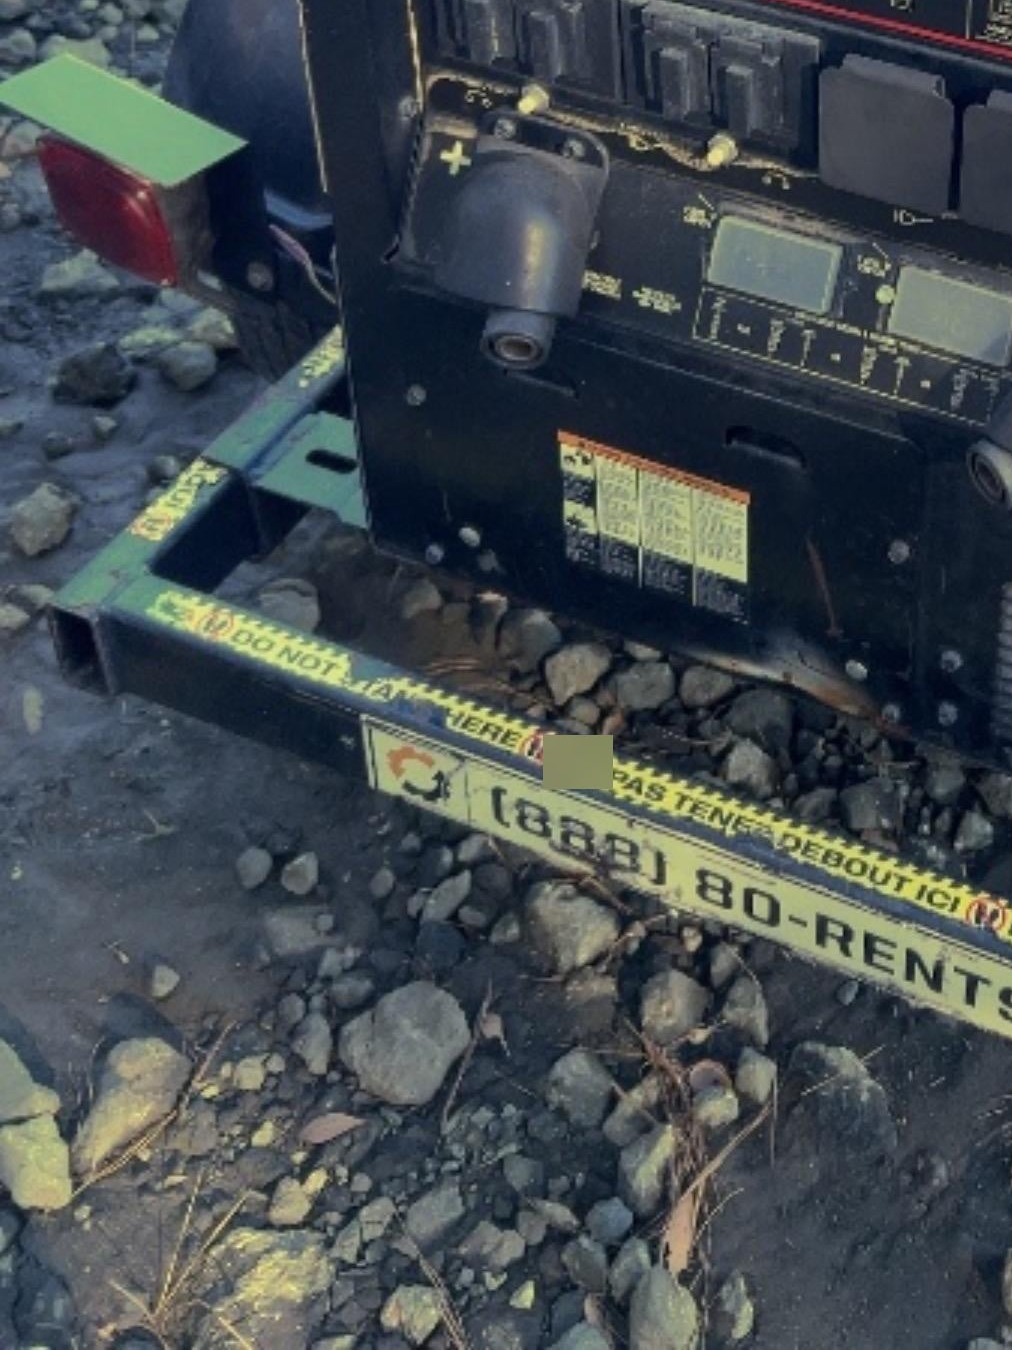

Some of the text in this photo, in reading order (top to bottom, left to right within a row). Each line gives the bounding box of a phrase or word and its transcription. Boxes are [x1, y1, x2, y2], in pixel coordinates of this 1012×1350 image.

[231, 630, 275, 651] DO
[278, 645, 337, 676] NOT
[491, 784, 668, 886] (888)
[780, 832, 913, 893] DEBOUT
[914, 883, 961, 913] ICI
